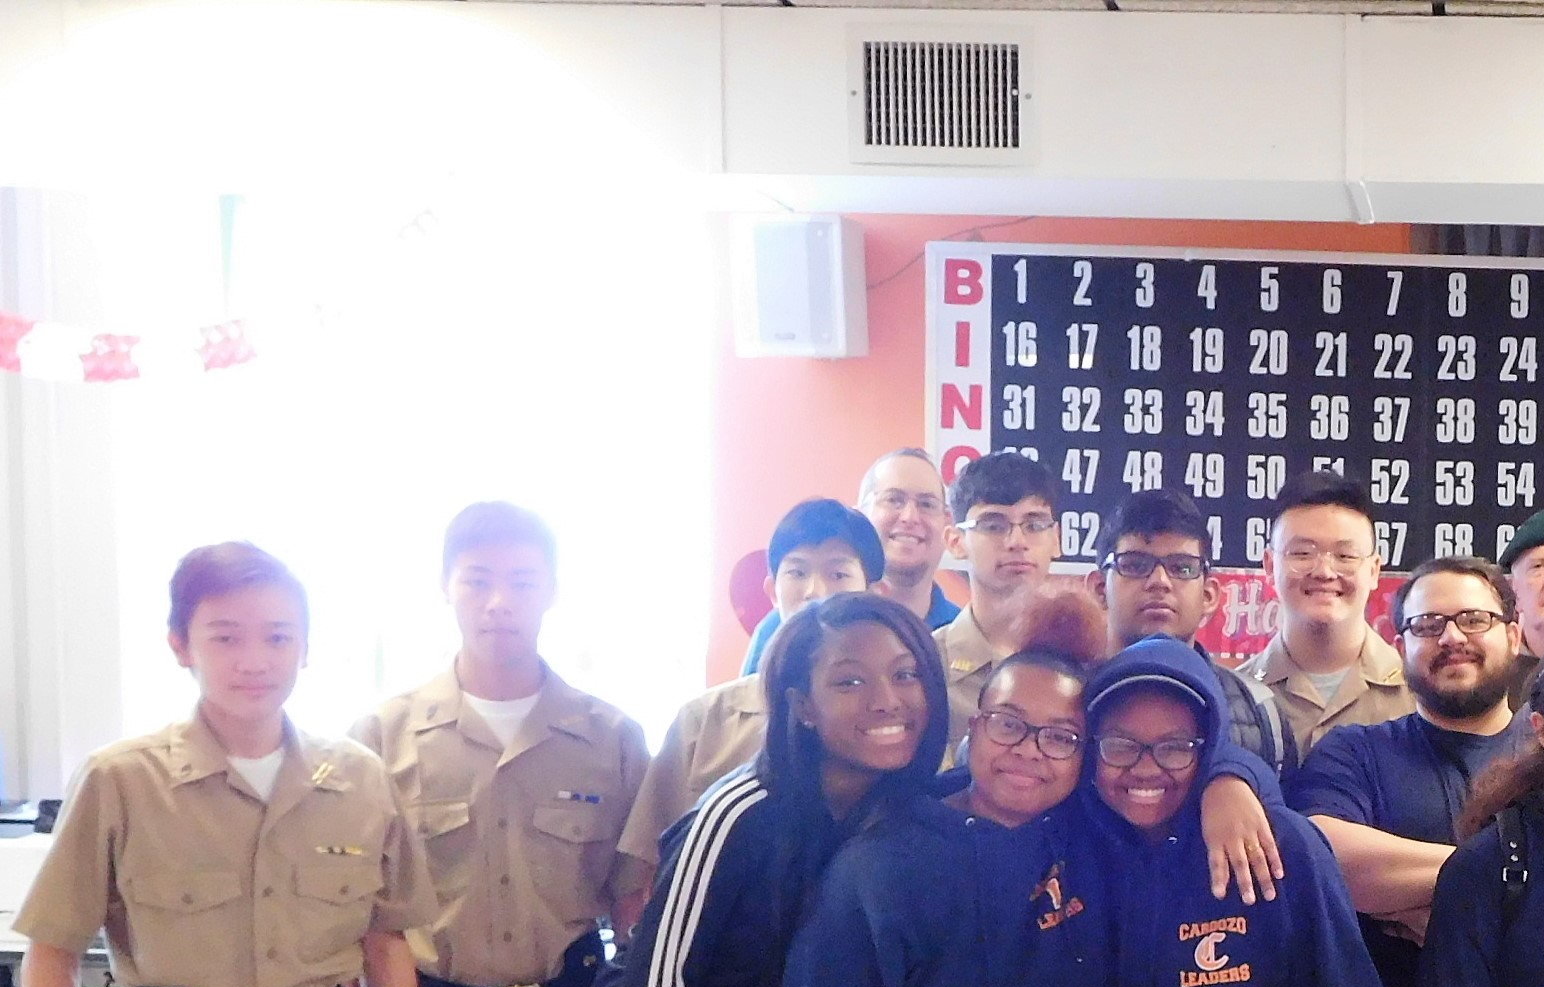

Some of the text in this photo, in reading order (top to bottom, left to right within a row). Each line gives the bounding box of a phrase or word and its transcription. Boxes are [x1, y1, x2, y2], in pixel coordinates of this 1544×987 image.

[1013, 258, 1028, 304] 1
[1072, 260, 1093, 306] 2
[1135, 262, 1155, 308] 3
[1196, 264, 1218, 310] 4
[1260, 266, 1279, 312] 5
[1322, 268, 1342, 315] 6
[1386, 270, 1403, 317] 7
[1447, 272, 1467, 318] 8
[1510, 274, 1529, 319] 9
[1002, 321, 1038, 368] 16
[1065, 323, 1099, 370] 17
[1126, 325, 1162, 372] 18
[1189, 327, 1224, 374] 19
[1249, 329, 1289, 376] 20
[1314, 331, 1347, 378] 21
[1373, 333, 1413, 380] 22
[1437, 335, 1477, 381] 23
[1499, 337, 1538, 383] 24
[1002, 384, 1037, 431] 31
[1061, 386, 1102, 433] 32
[1123, 388, 1163, 435] 33
[1185, 391, 1226, 437] 34
[1247, 393, 1287, 439] 35
[1310, 395, 1350, 441] 36
[1373, 397, 1411, 443] 37
[1436, 398, 1476, 444] 38
[1498, 400, 1537, 446] 39
[1061, 448, 1101, 495] 47
[1122, 450, 1163, 494] 48
[1184, 453, 1225, 499] 49
[1246, 455, 1287, 501] 50
[1370, 459, 1410, 505] 52
[1435, 460, 1475, 506] 53
[1497, 462, 1536, 508] 54
[1060, 511, 1100, 557] 62
[1246, 517, 1271, 562] 6
[1179, 963, 1251, 987] LEADERS
